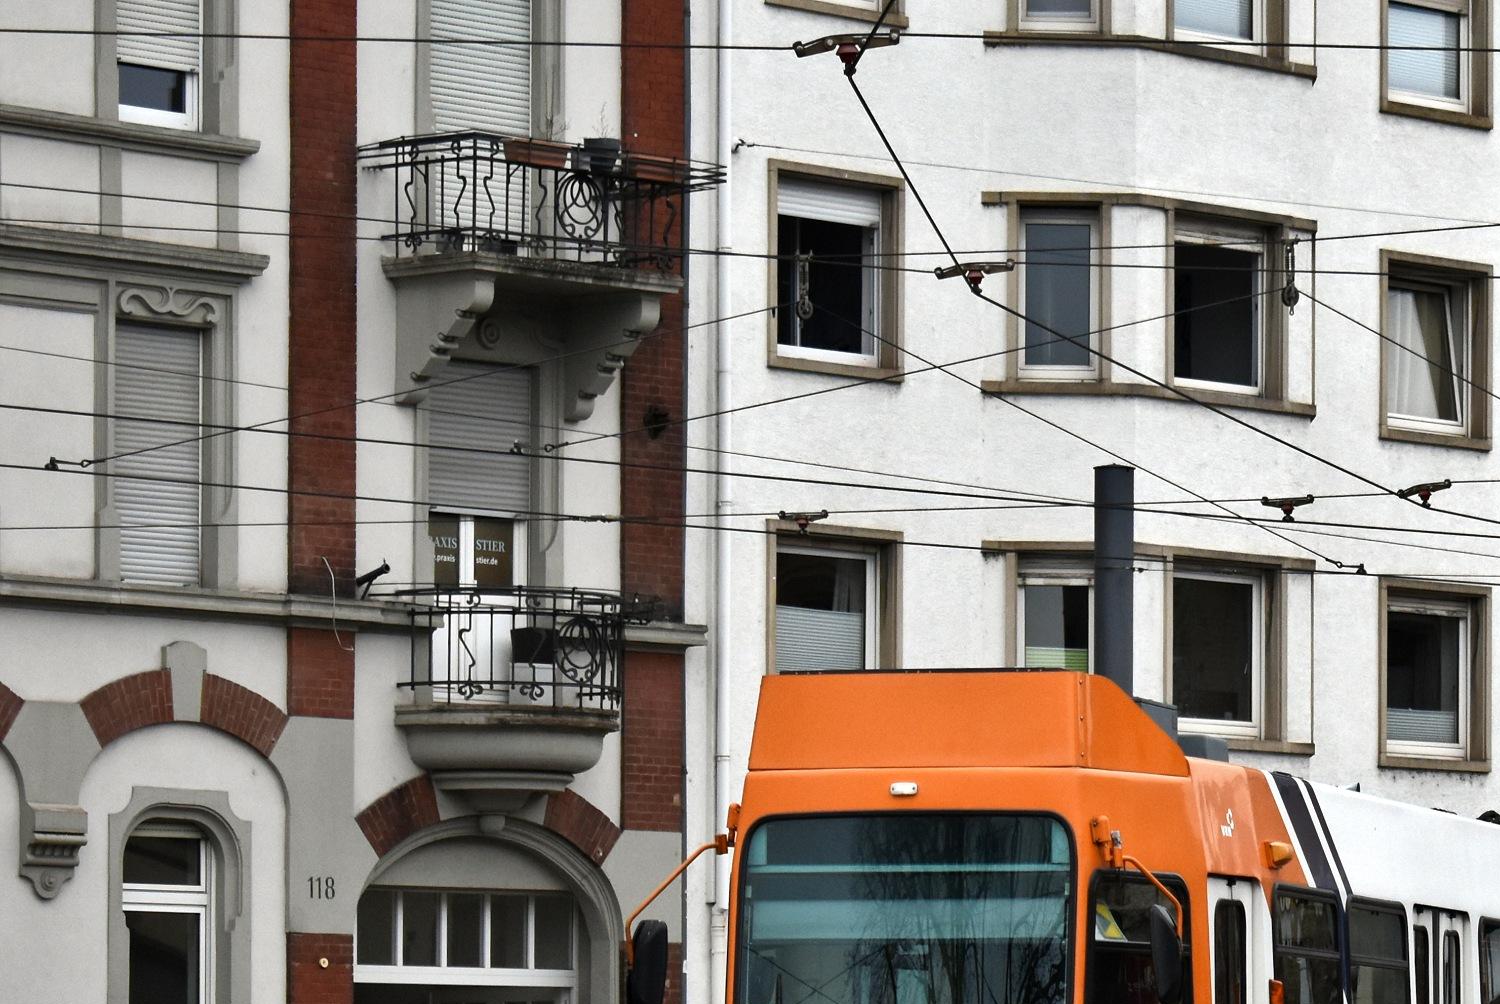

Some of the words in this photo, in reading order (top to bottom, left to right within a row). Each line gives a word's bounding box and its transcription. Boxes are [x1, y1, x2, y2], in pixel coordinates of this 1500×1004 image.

[431, 536, 458, 549] AXIS
[475, 539, 506, 553] STIER
[307, 876, 336, 900] 118
